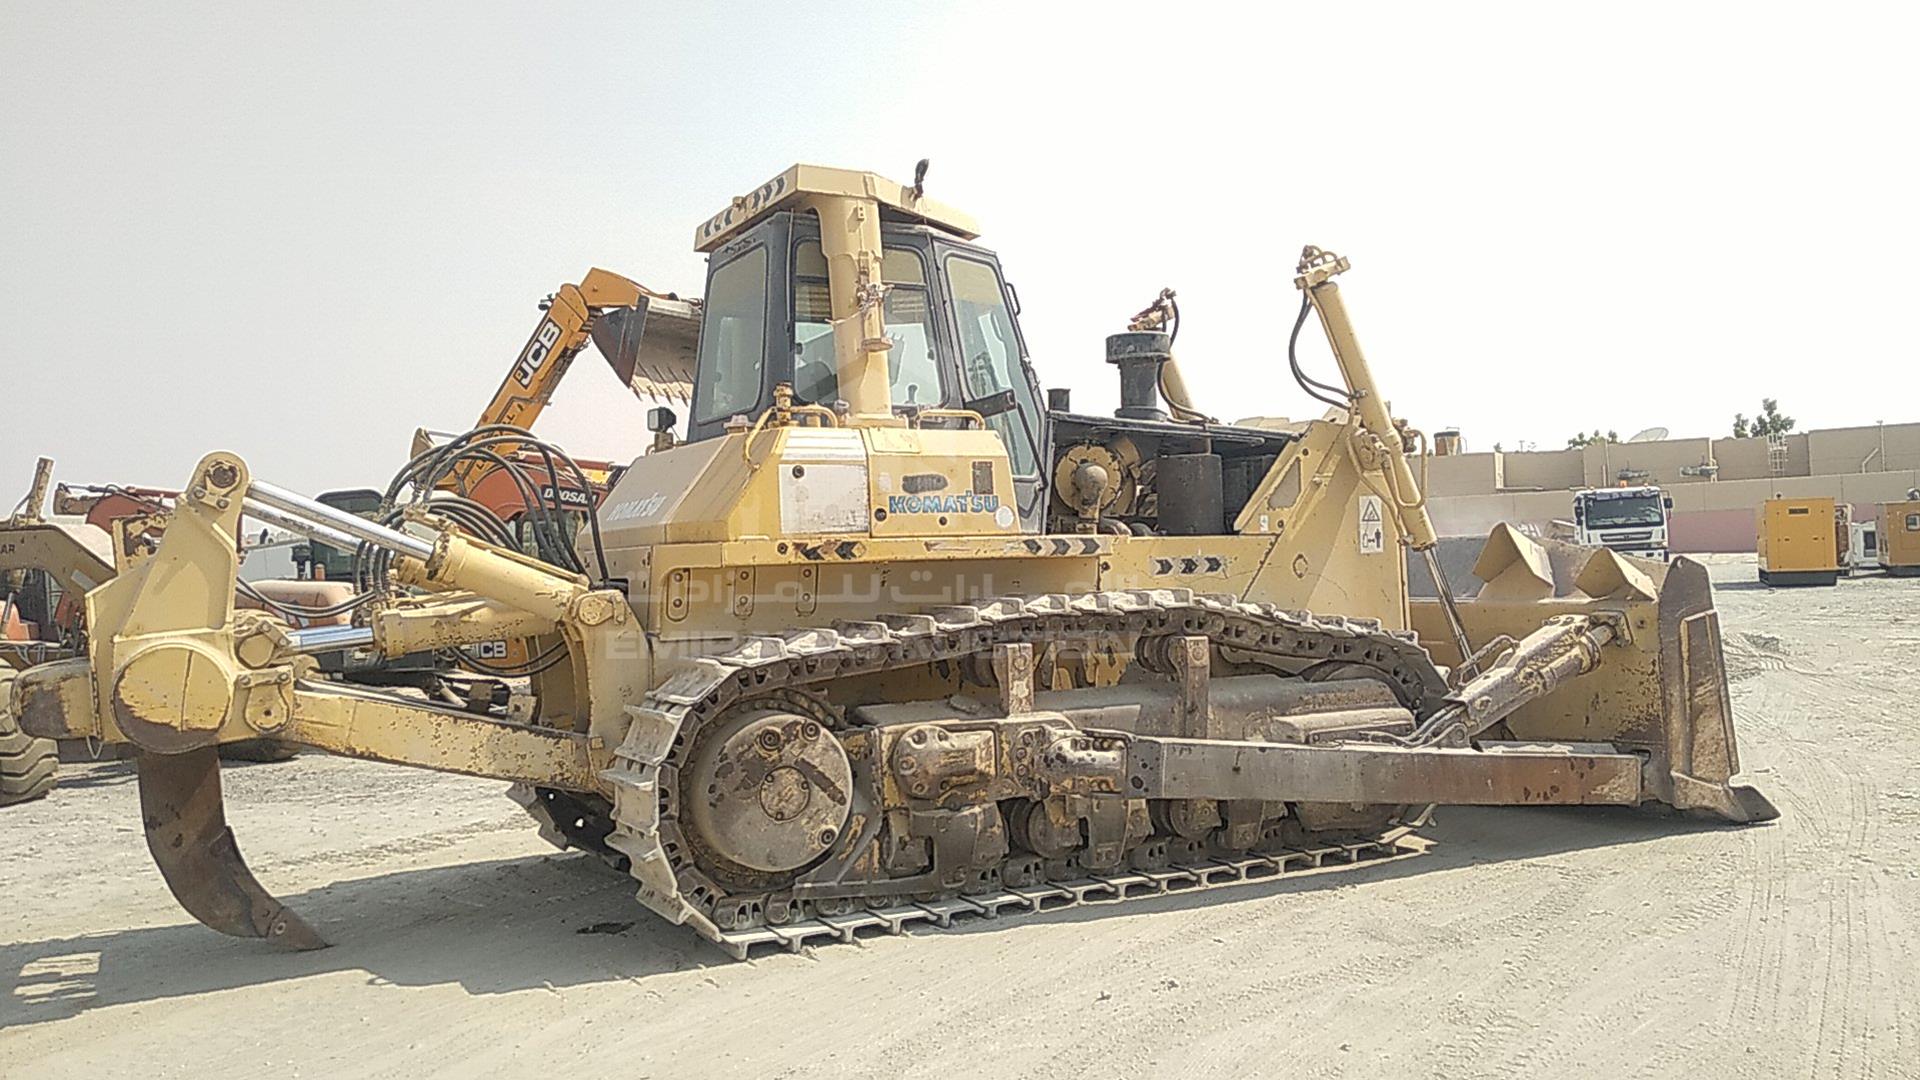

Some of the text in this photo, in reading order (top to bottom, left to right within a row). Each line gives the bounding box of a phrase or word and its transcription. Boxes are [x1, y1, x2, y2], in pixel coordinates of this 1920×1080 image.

[519, 321, 561, 386] JCB
[543, 487, 597, 505] DOSA
[889, 490, 999, 514] KOMATSU
